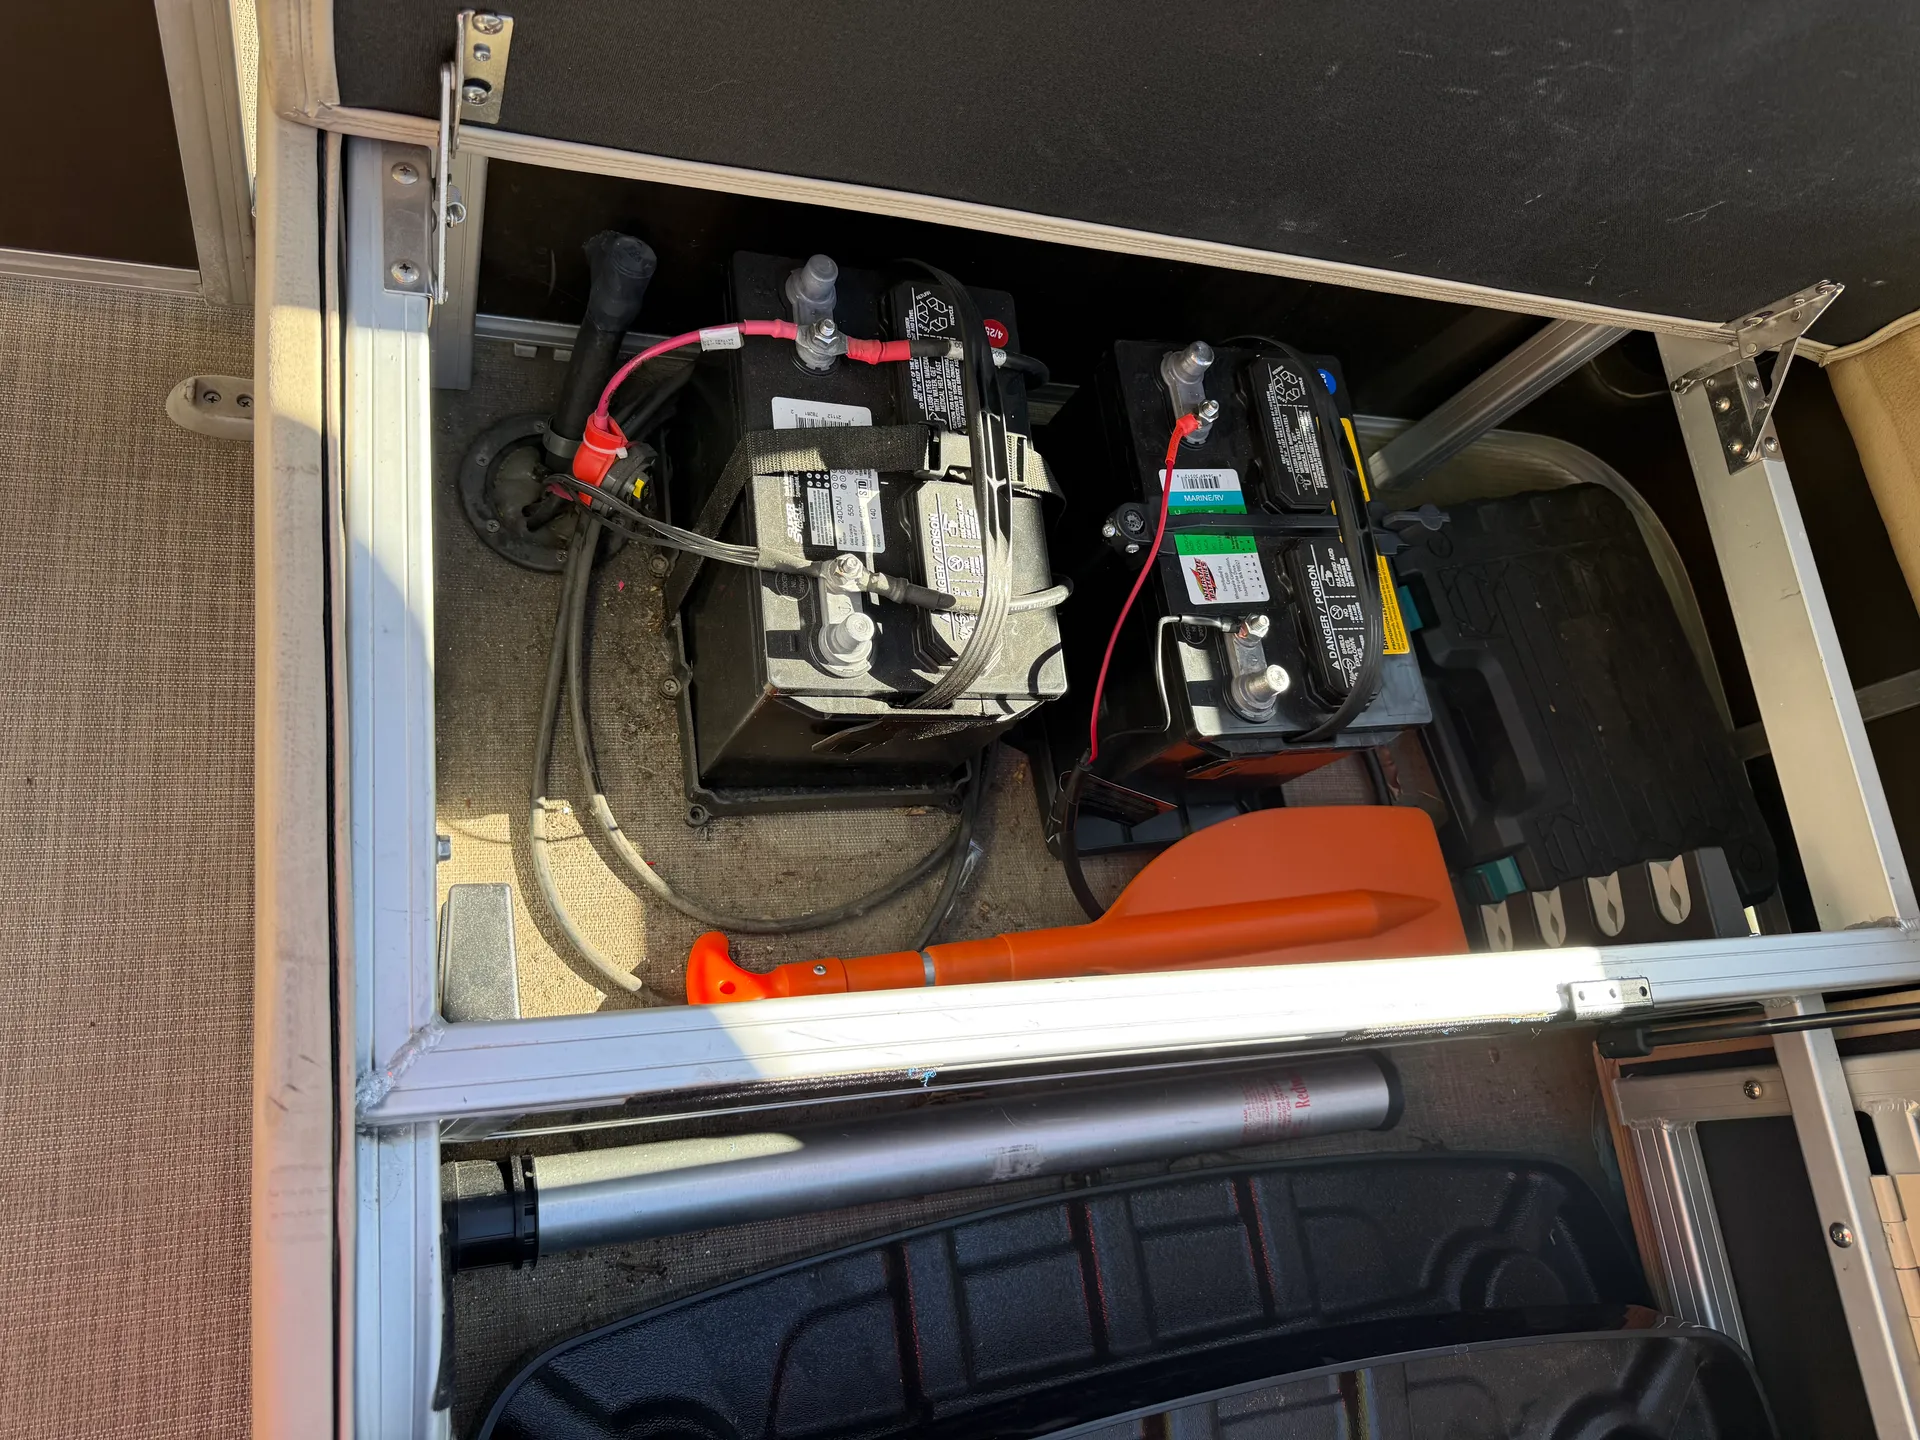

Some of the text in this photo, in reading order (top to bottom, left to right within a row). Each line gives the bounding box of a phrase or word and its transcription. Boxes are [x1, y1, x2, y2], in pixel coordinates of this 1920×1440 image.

[919, 401, 924, 409] DO
[938, 389, 946, 412] MEDICAL
[1282, 413, 1293, 445] IMMEDIATELY
[1300, 452, 1309, 473] MEDICAL
[857, 480, 867, 496] STD
[785, 502, 795, 537] SUPER
[835, 495, 844, 523] 24DCMJ
[927, 512, 942, 553] POISON
[1194, 556, 1209, 600] INTERSTATE
[1201, 560, 1215, 599] BATTERIES
[1327, 547, 1342, 587] SULFURIC ACID
[1306, 562, 1323, 604] POISON
[1342, 607, 1349, 617] NO
[1319, 613, 1337, 659] DANGER
[1337, 633, 1347, 654] SHIELD
[1344, 639, 1352, 654] EYES
[1384, 616, 1396, 650] PROPOSITION
[1348, 635, 1361, 666] EXPLOSIVE
